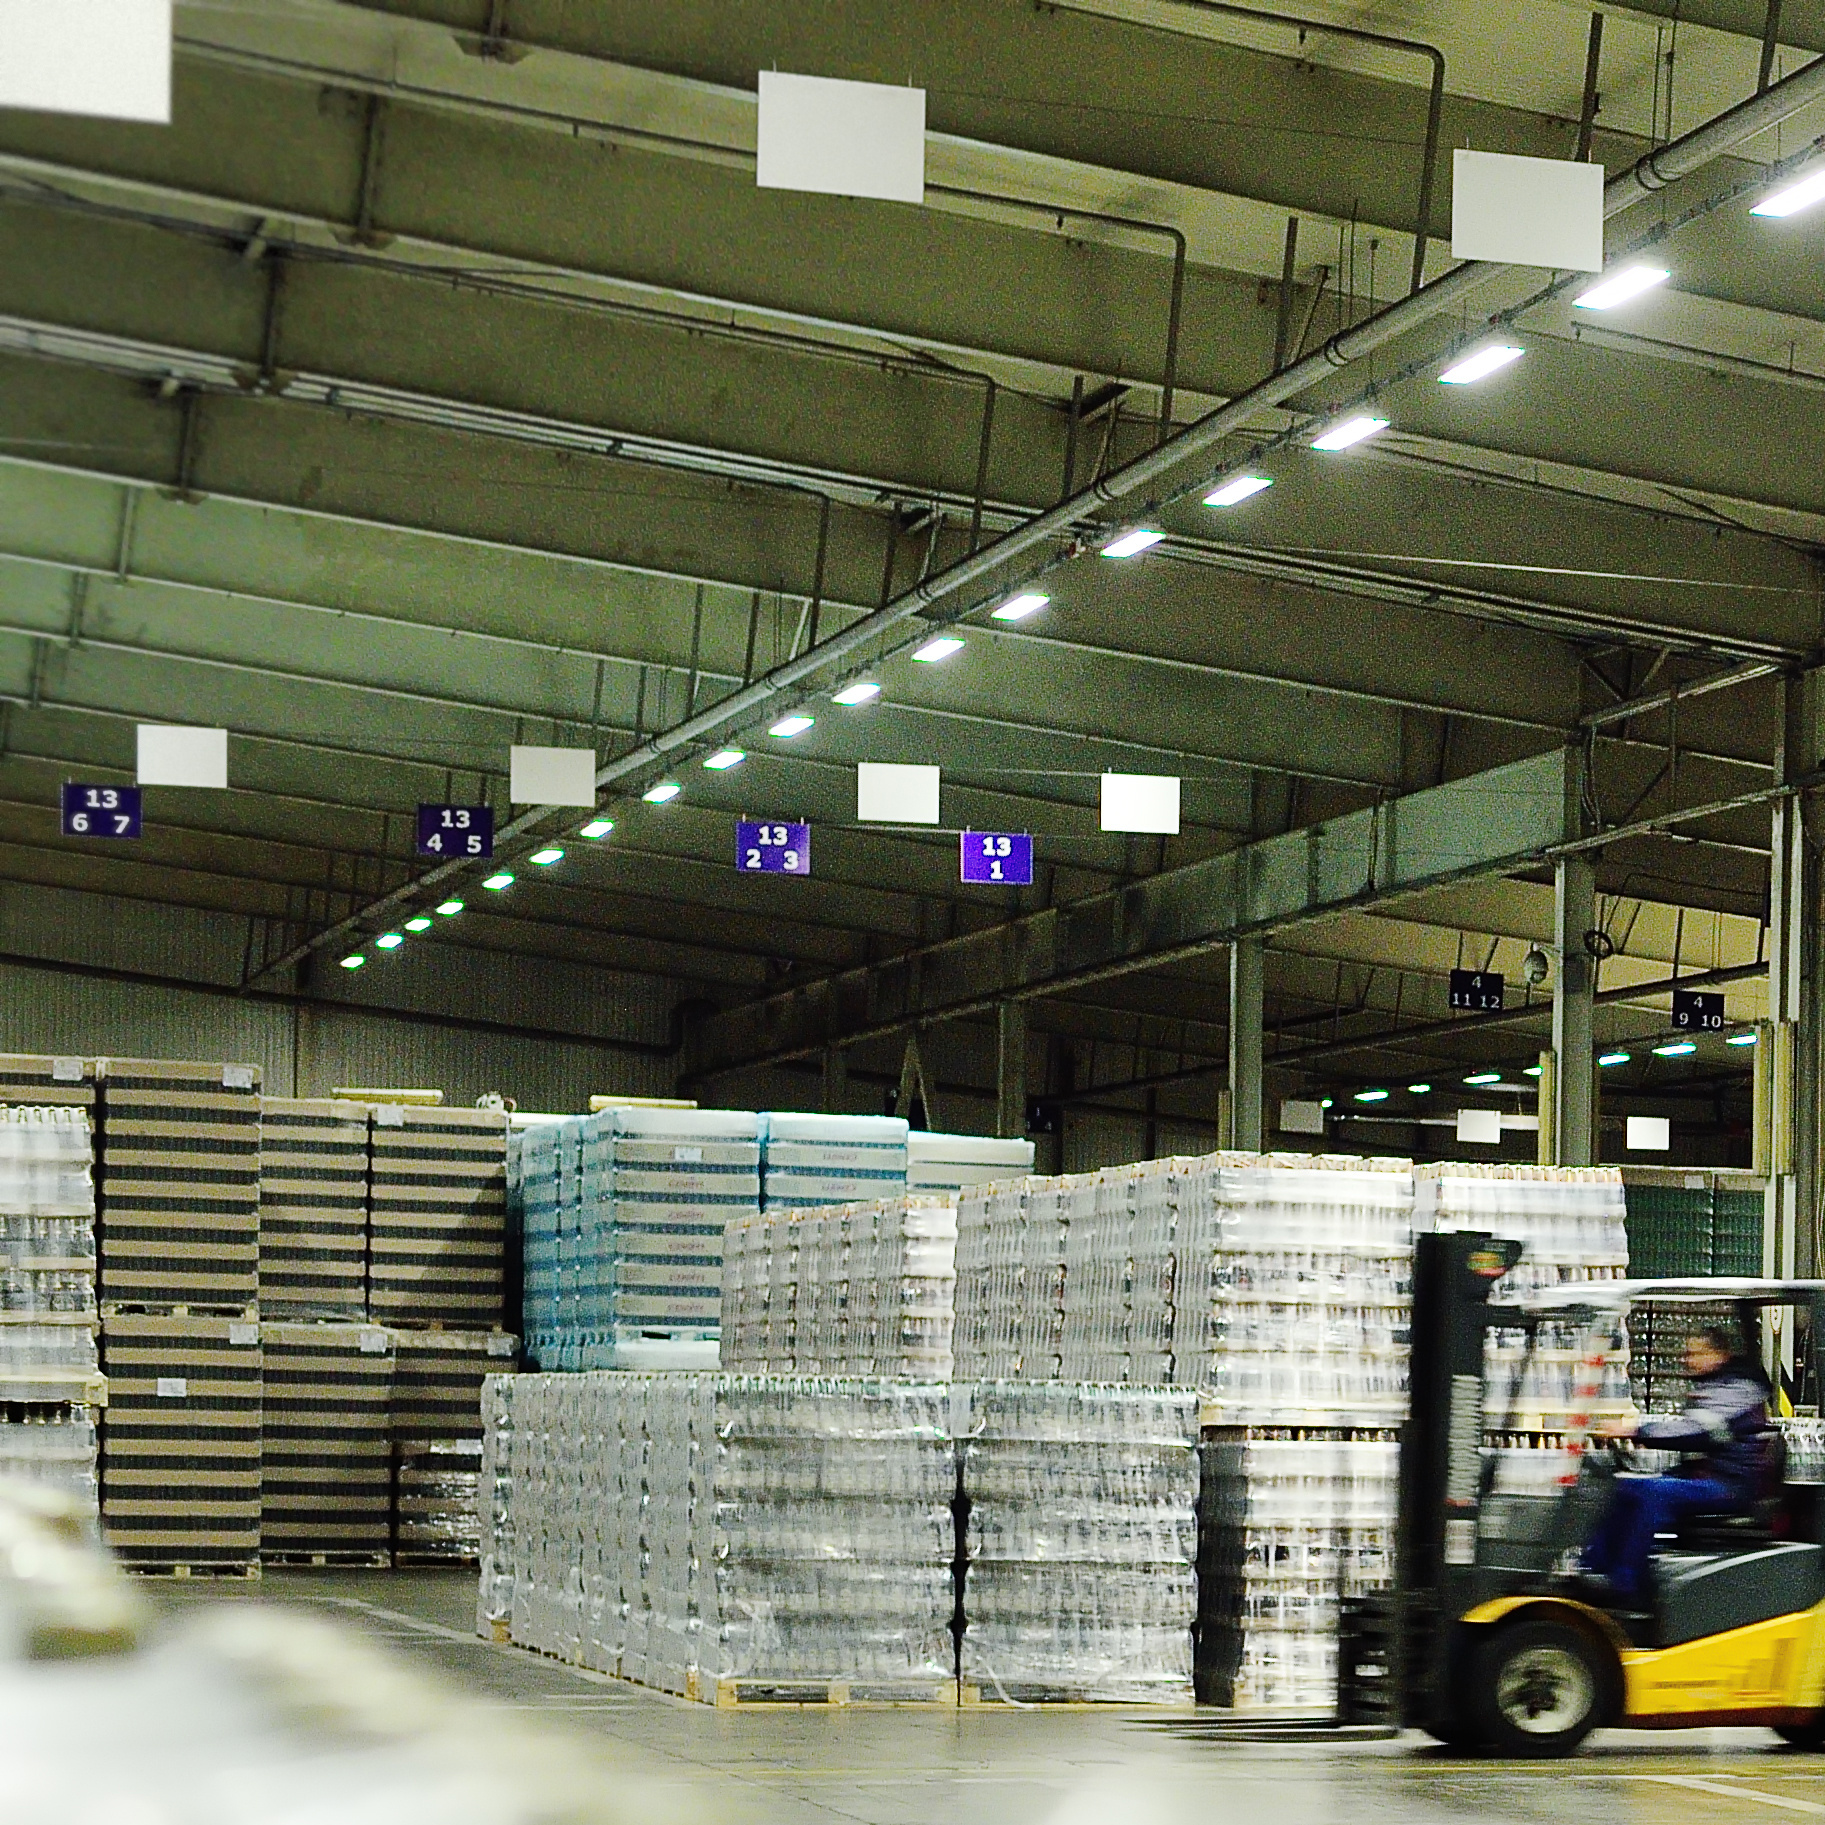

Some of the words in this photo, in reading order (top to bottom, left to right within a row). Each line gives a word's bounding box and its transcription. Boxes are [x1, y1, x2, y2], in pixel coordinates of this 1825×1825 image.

[86, 788, 119, 809] 13
[71, 812, 89, 832] 6
[113, 814, 131, 834] 7
[441, 809, 471, 829] 13
[426, 833, 443, 852] 4
[466, 834, 482, 854] 5
[758, 825, 788, 846] 13
[982, 836, 1012, 857] 13
[746, 848, 762, 869] 2
[783, 850, 799, 871] 3
[990, 860, 1004, 881] 1
[1471, 975, 1482, 989] 4
[1453, 992, 1471, 1006] 11
[1480, 995, 1500, 1009] 12
[1693, 995, 1703, 1008] 4
[1679, 1012, 1689, 1025] 9
[1701, 1014, 1722, 1028] 10
